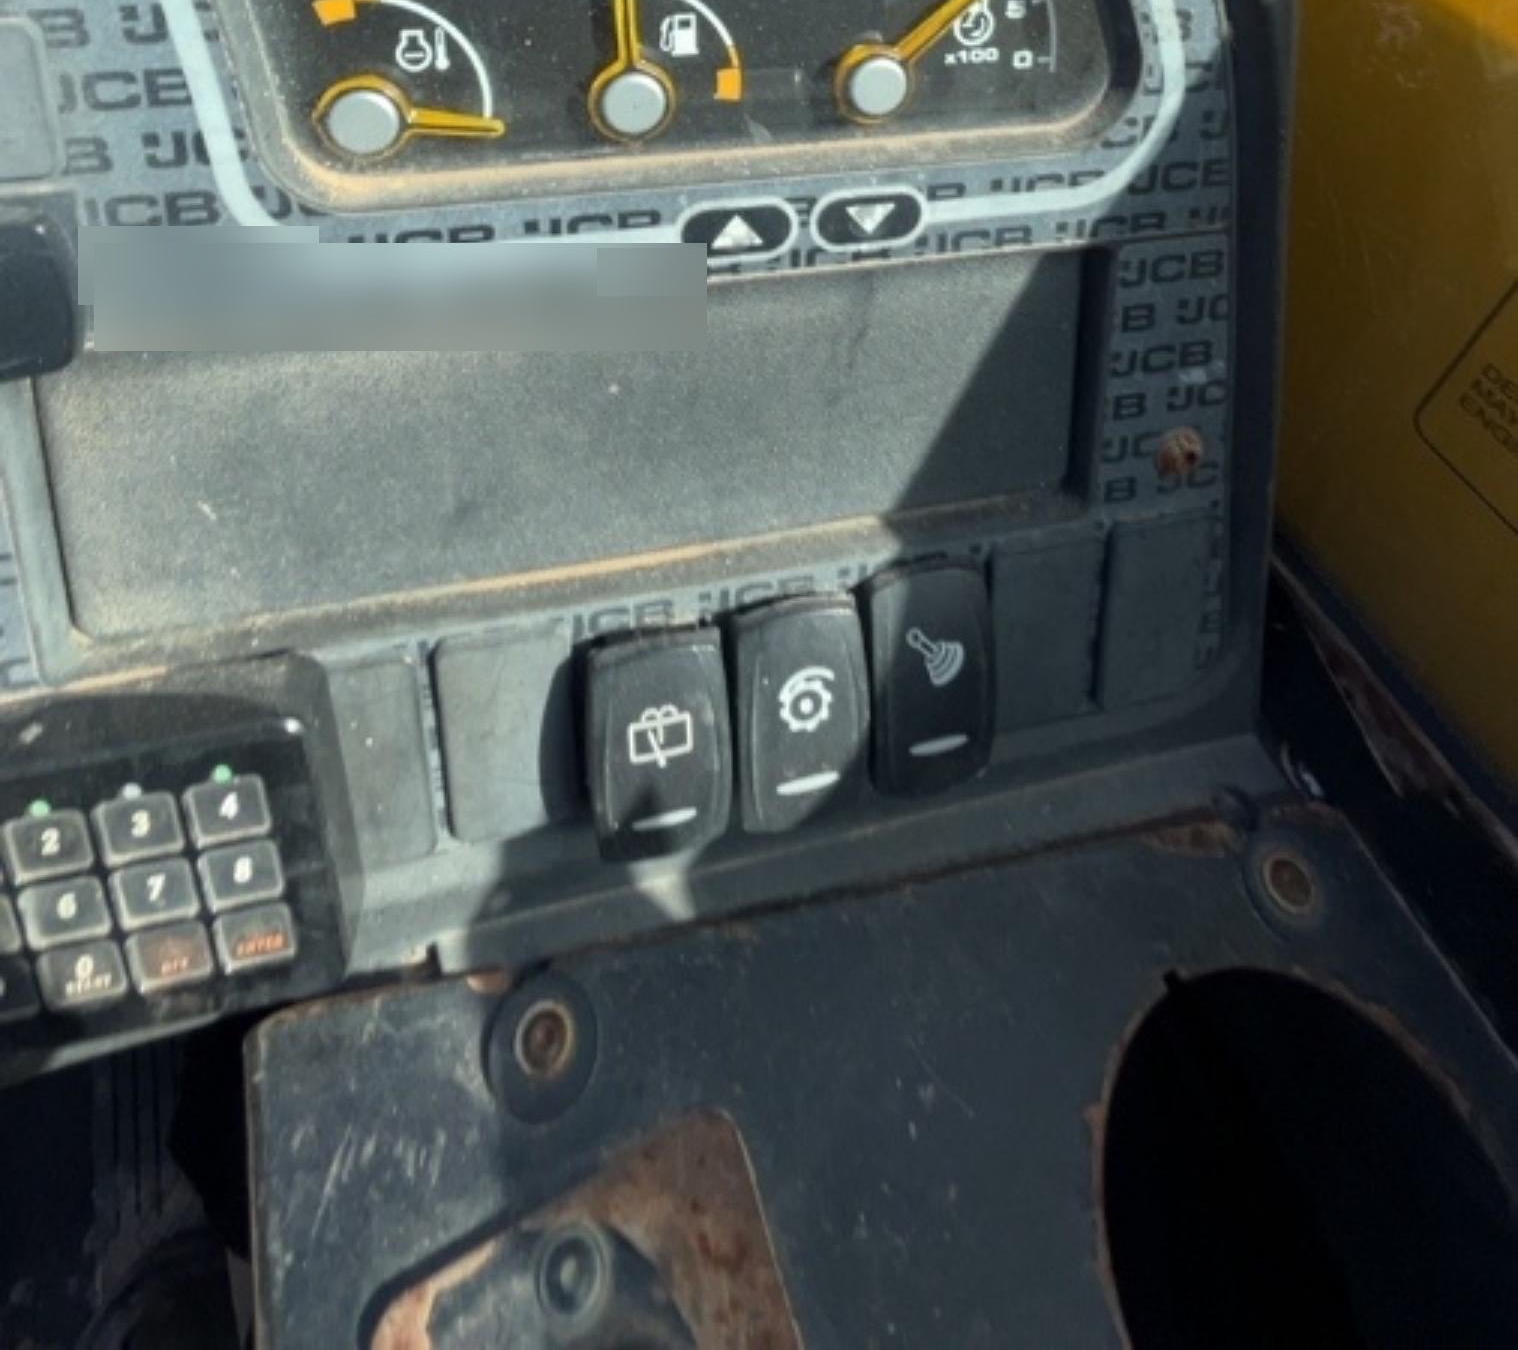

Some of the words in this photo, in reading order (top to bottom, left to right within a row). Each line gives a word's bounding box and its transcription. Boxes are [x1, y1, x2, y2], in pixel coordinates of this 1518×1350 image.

[1005, 0, 1027, 20] 5
[944, 48, 999, 65] x100
[1012, 50, 1034, 70] 0
[1119, 250, 1224, 289] JCB
[1110, 339, 1213, 378] JCB
[40, 827, 61, 856] 2
[130, 809, 151, 838] 3
[218, 791, 239, 820] 4
[56, 892, 77, 920] 6
[146, 873, 167, 901] 7
